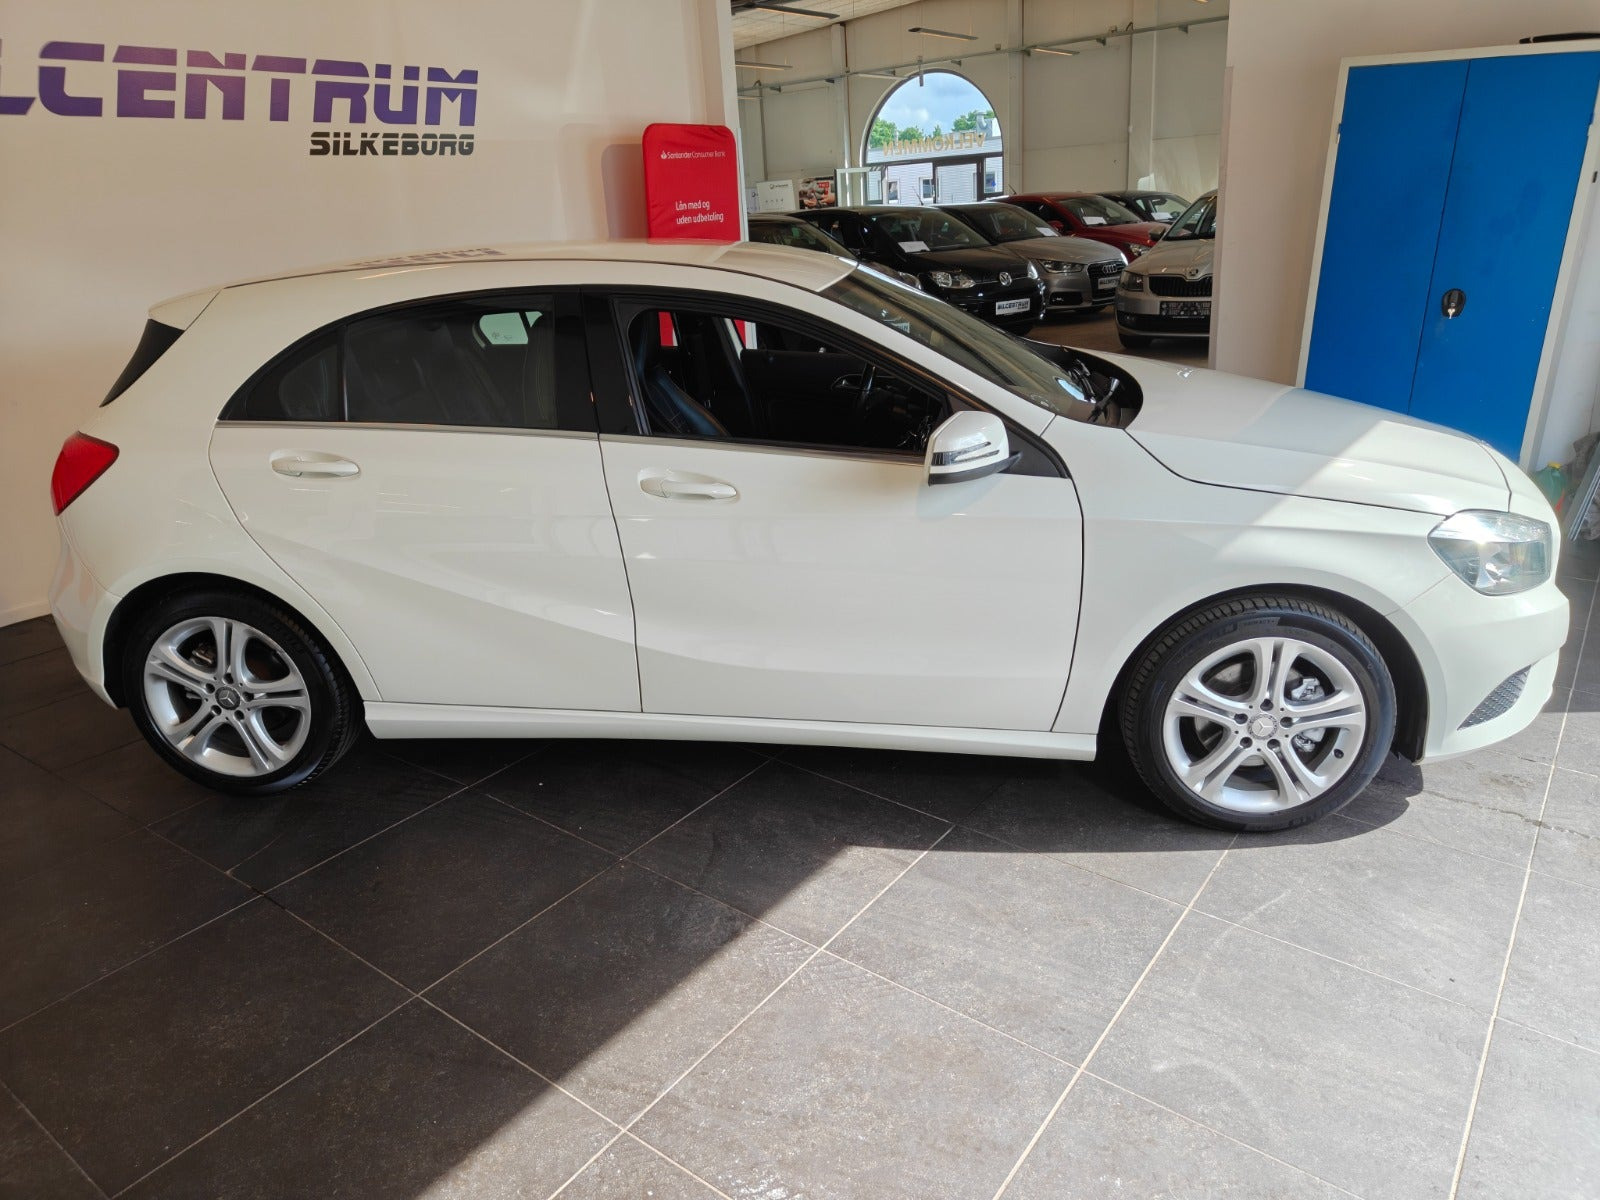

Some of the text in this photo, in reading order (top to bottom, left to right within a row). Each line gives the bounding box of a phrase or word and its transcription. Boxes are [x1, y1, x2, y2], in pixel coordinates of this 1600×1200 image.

[309, 131, 475, 156] SILKEBORG
[667, 151, 691, 159] Santander
[675, 200, 710, 211] Lån med og
[676, 211, 724, 225] uden udbetaling
